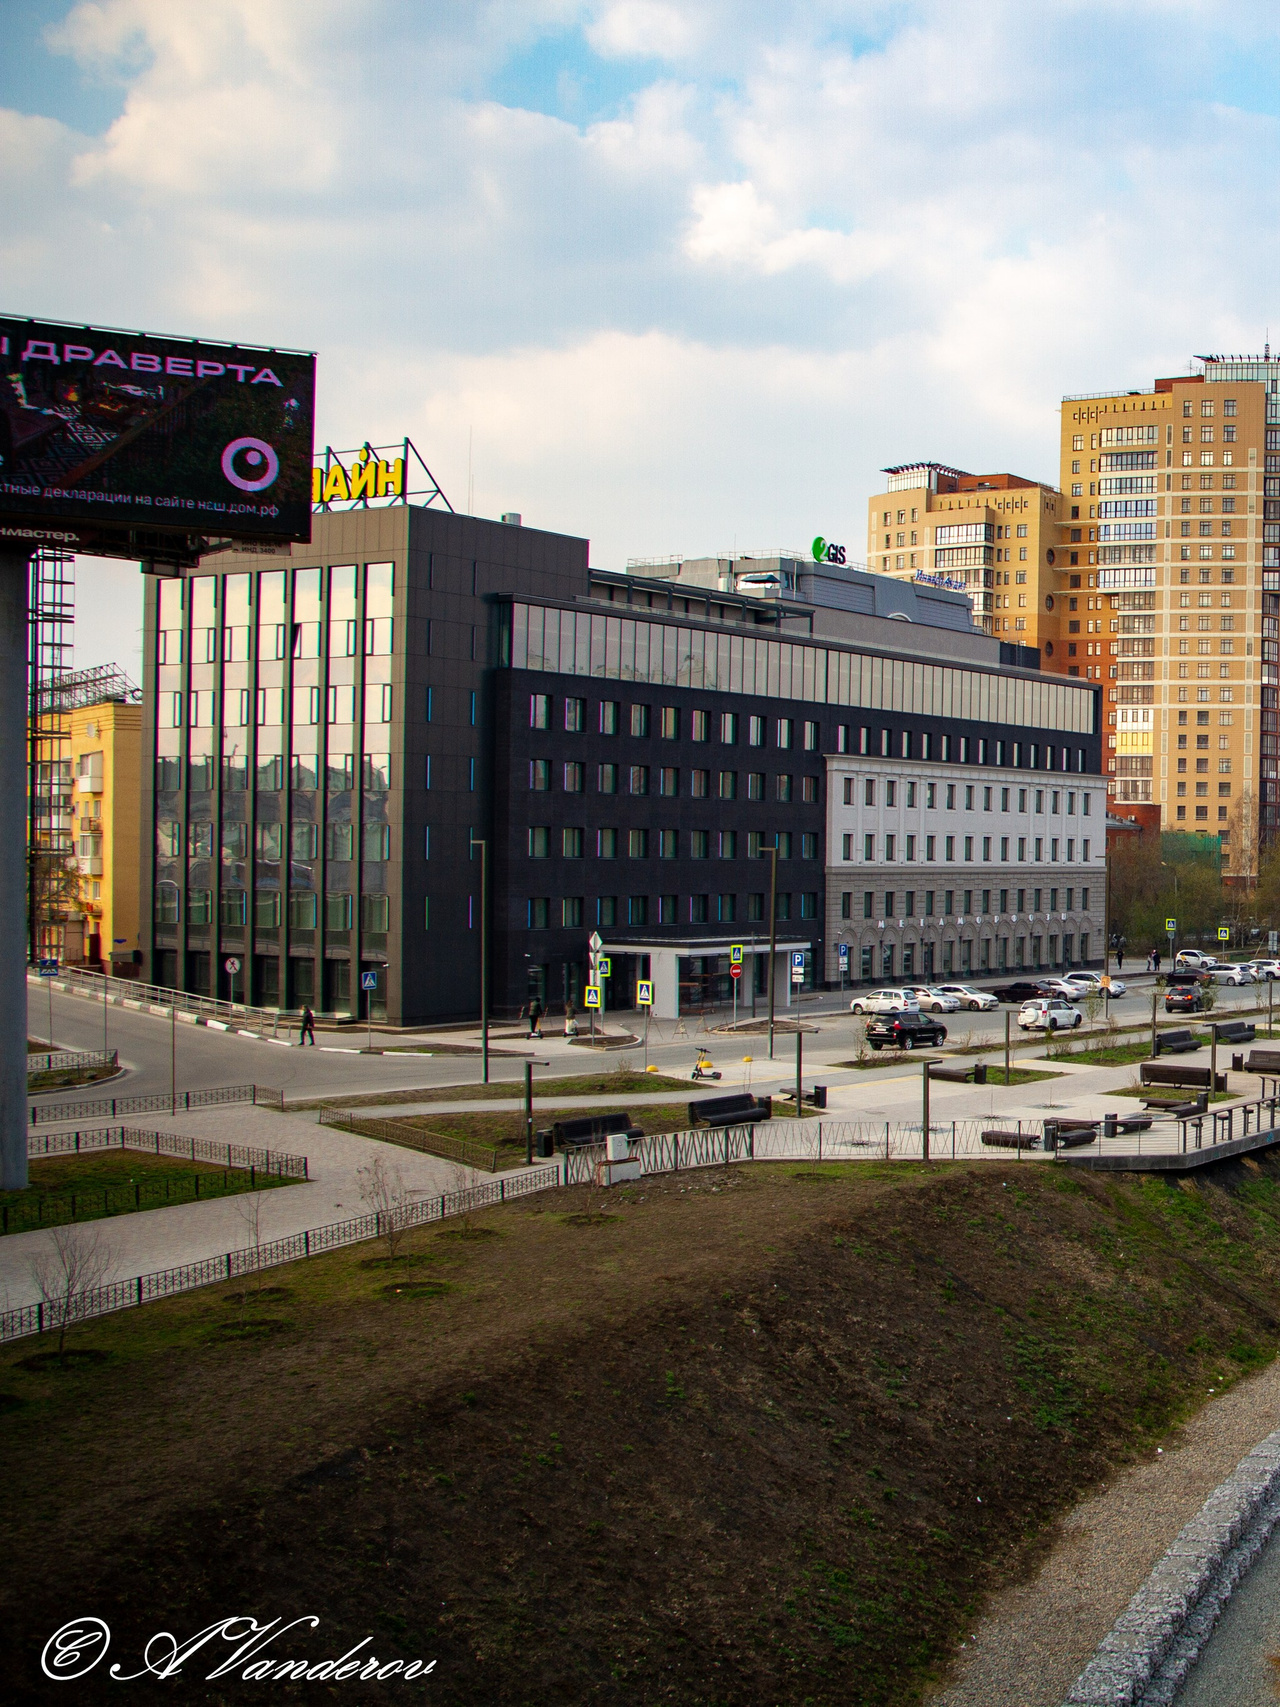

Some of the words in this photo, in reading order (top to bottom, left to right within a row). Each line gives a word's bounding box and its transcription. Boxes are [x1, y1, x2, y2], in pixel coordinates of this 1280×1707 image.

[21, 340, 284, 387] ДРАВЕРТА
[44, 487, 132, 504] декларации
[135, 495, 152, 507] на
[155, 496, 195, 509] сайте
[198, 500, 279, 518] наш.дом.рф
[818, 538, 846, 565] 2GIS
